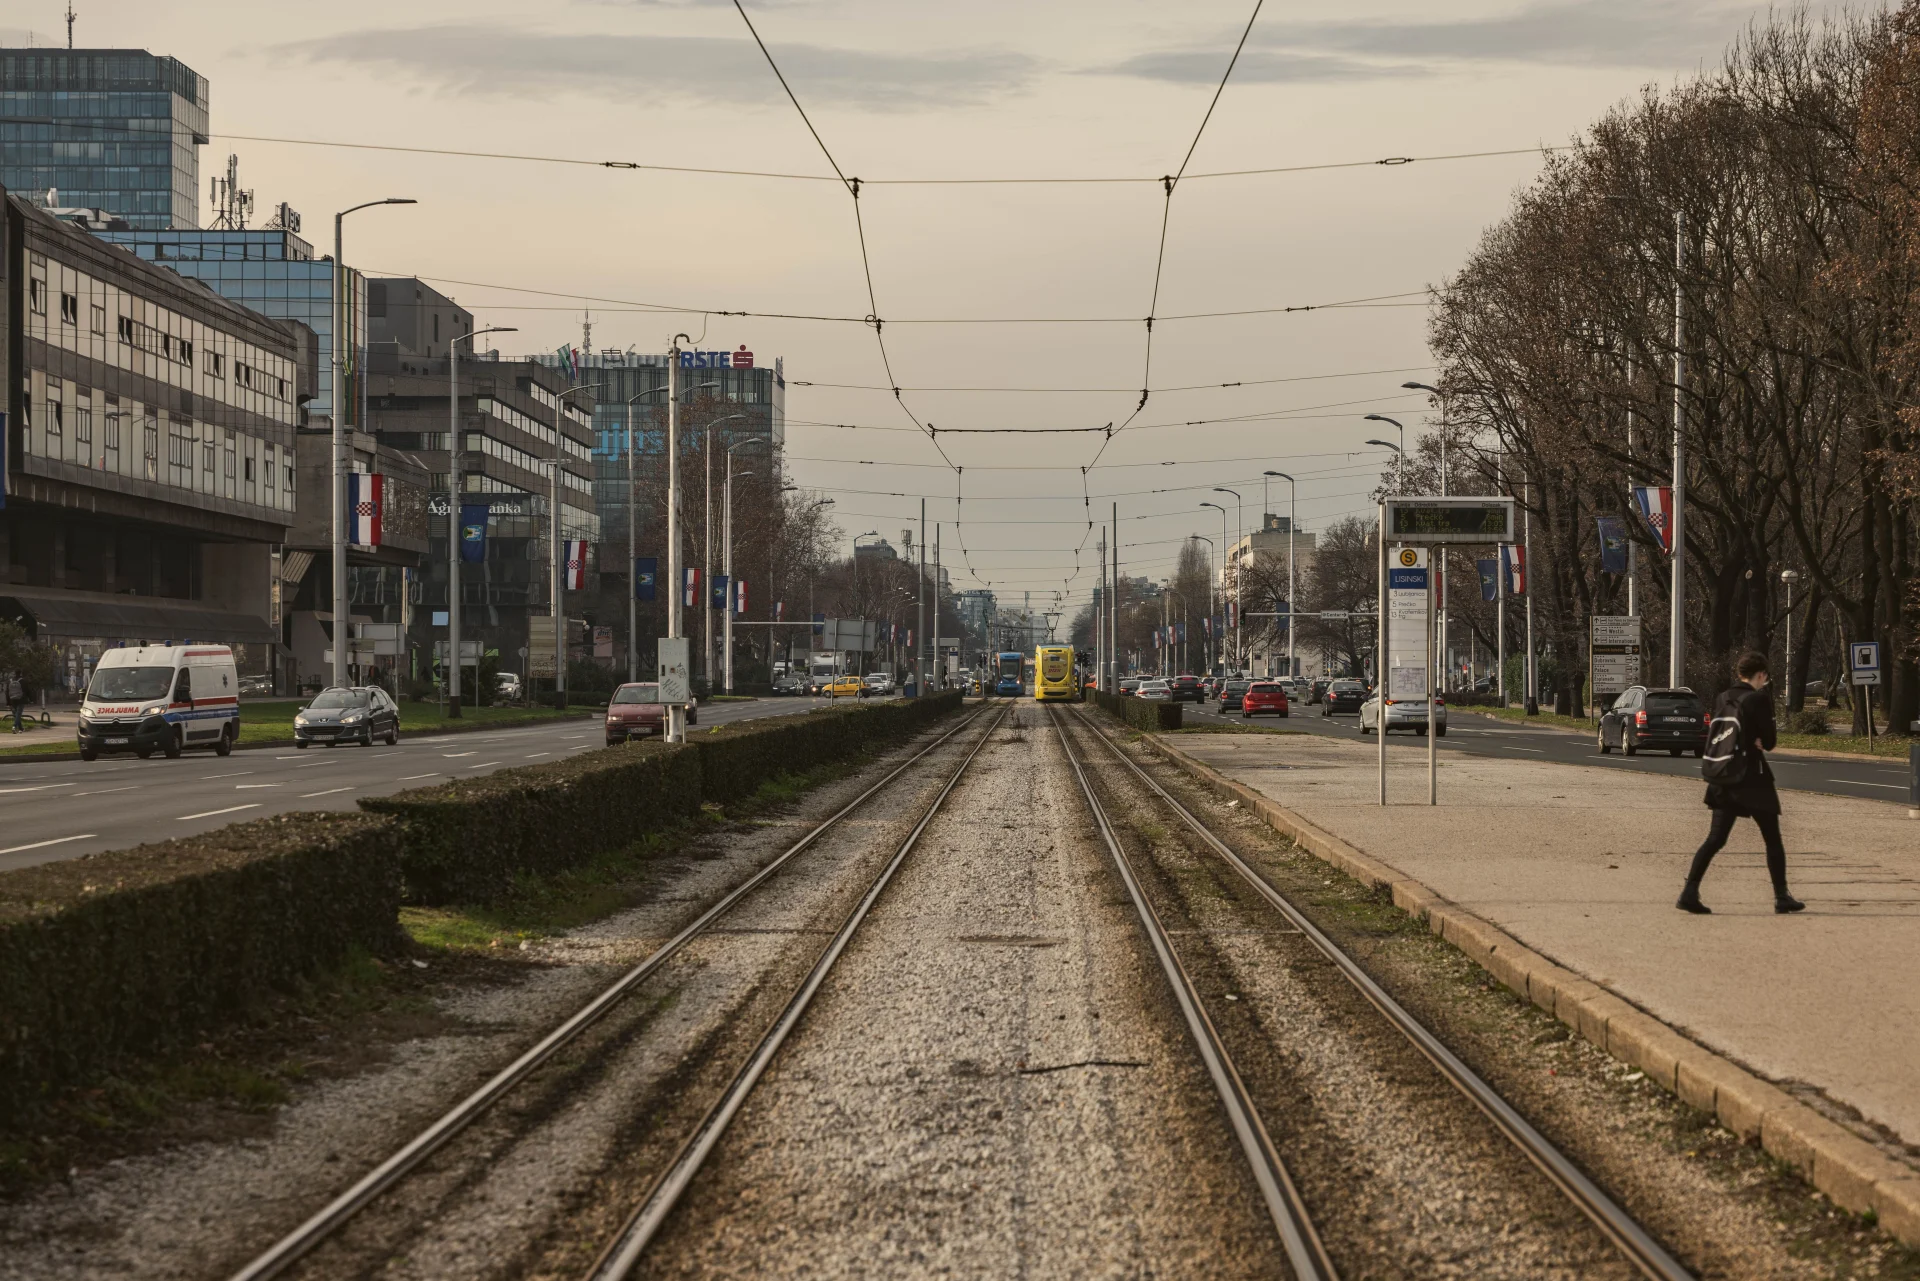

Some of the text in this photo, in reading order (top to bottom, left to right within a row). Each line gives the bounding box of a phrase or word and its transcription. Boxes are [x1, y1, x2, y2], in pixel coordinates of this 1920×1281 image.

[680, 351, 731, 369] RSTE
[488, 503, 521, 514] anka
[1404, 552, 1413, 563] S
[1395, 575, 1424, 583] LISINSKI
